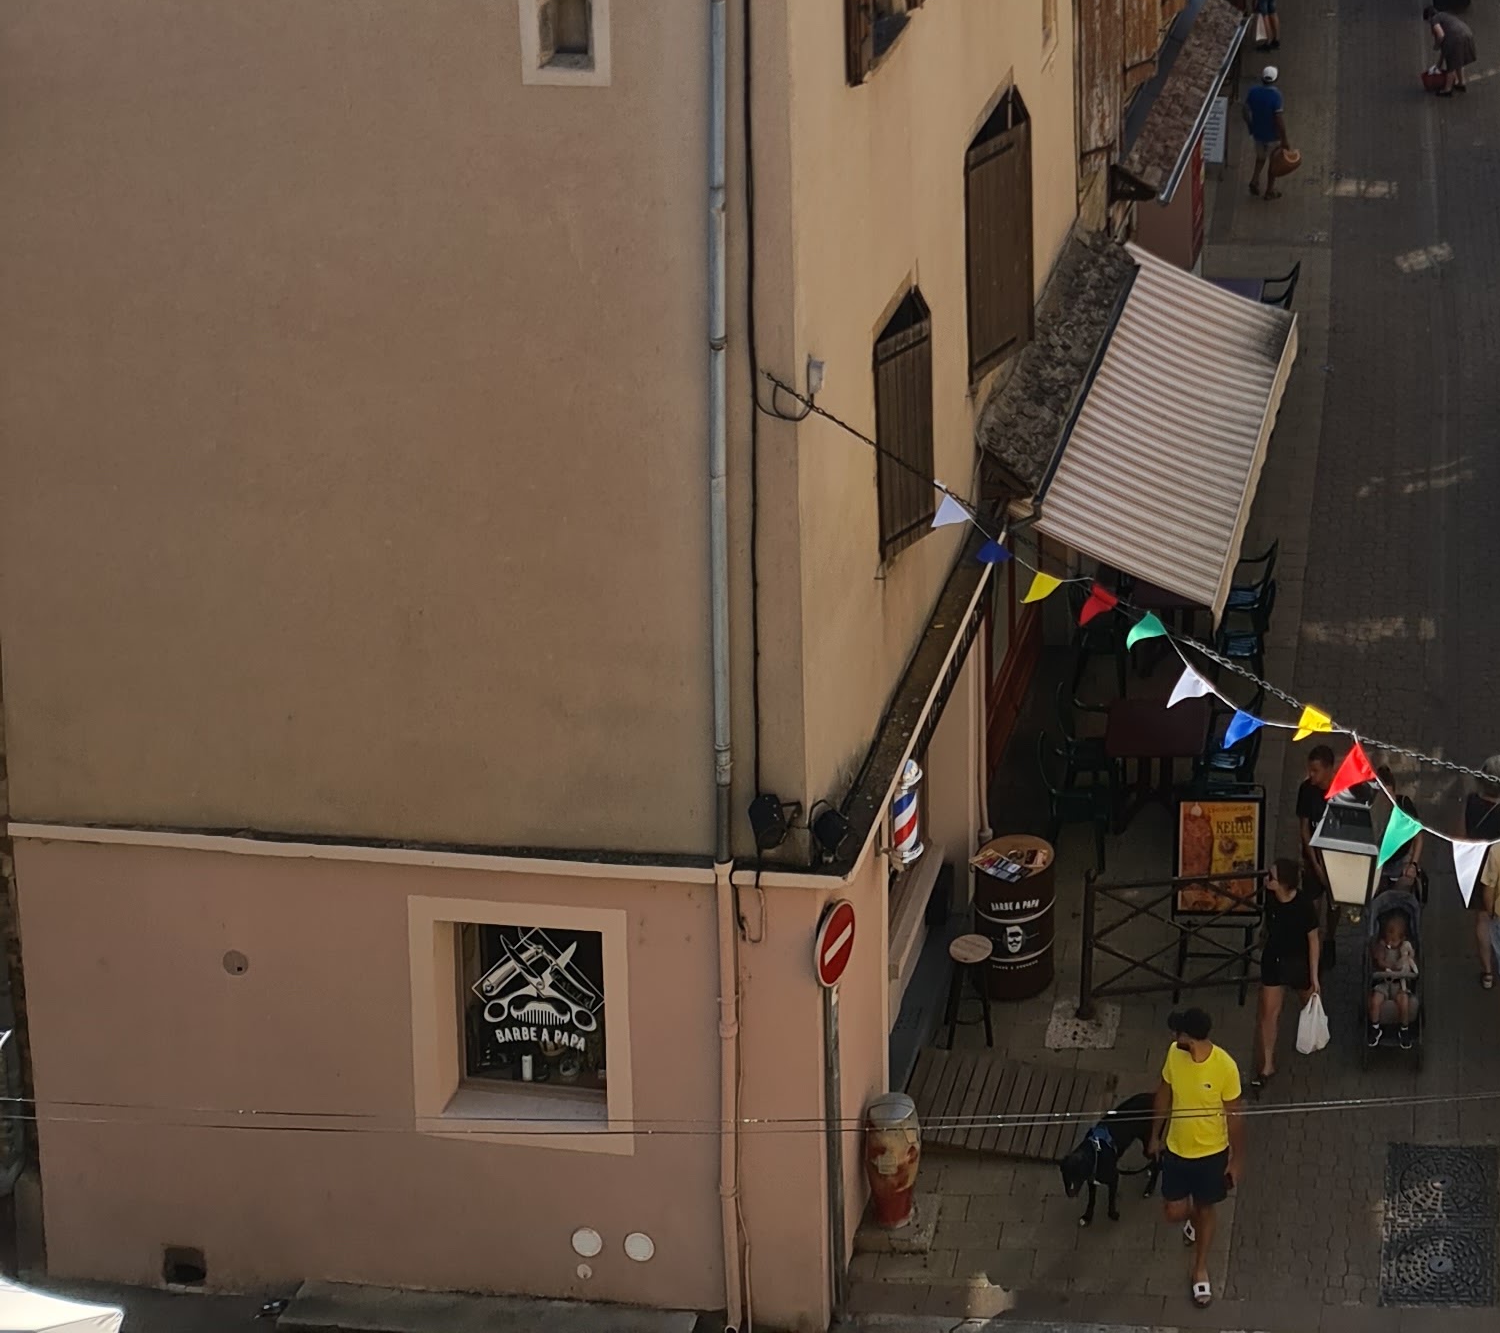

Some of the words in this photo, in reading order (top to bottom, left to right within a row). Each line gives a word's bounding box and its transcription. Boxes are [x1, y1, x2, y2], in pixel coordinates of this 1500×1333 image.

[1216, 820, 1253, 834] KEBAB
[495, 1026, 538, 1043] BARBE
[541, 1028, 550, 1042] A
[554, 1029, 586, 1052] PAPA
